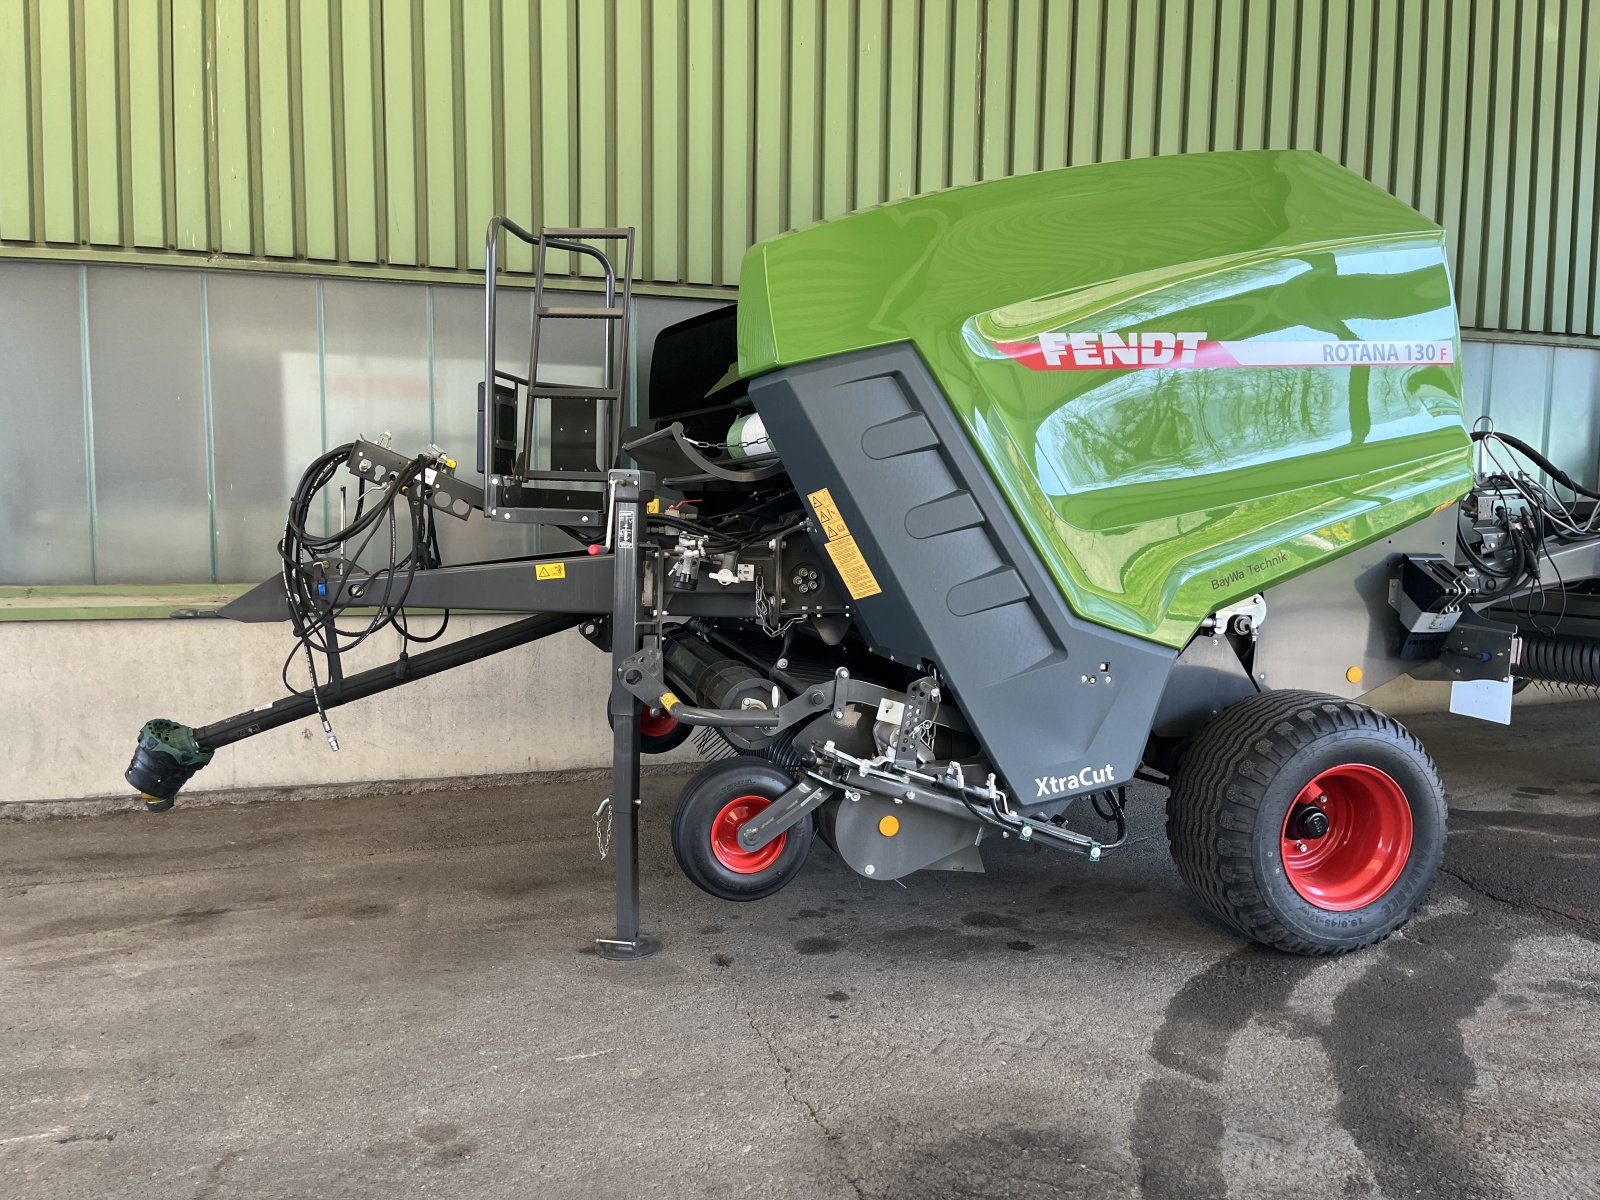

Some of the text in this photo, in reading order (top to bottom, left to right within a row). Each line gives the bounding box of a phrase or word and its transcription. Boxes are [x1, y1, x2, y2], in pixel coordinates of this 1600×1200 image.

[1038, 332, 1208, 365] FENDT
[1322, 343, 1447, 361] ROTANA 130 F
[1211, 551, 1288, 590] BayWa Technik
[1035, 764, 1115, 797] XtraCut
